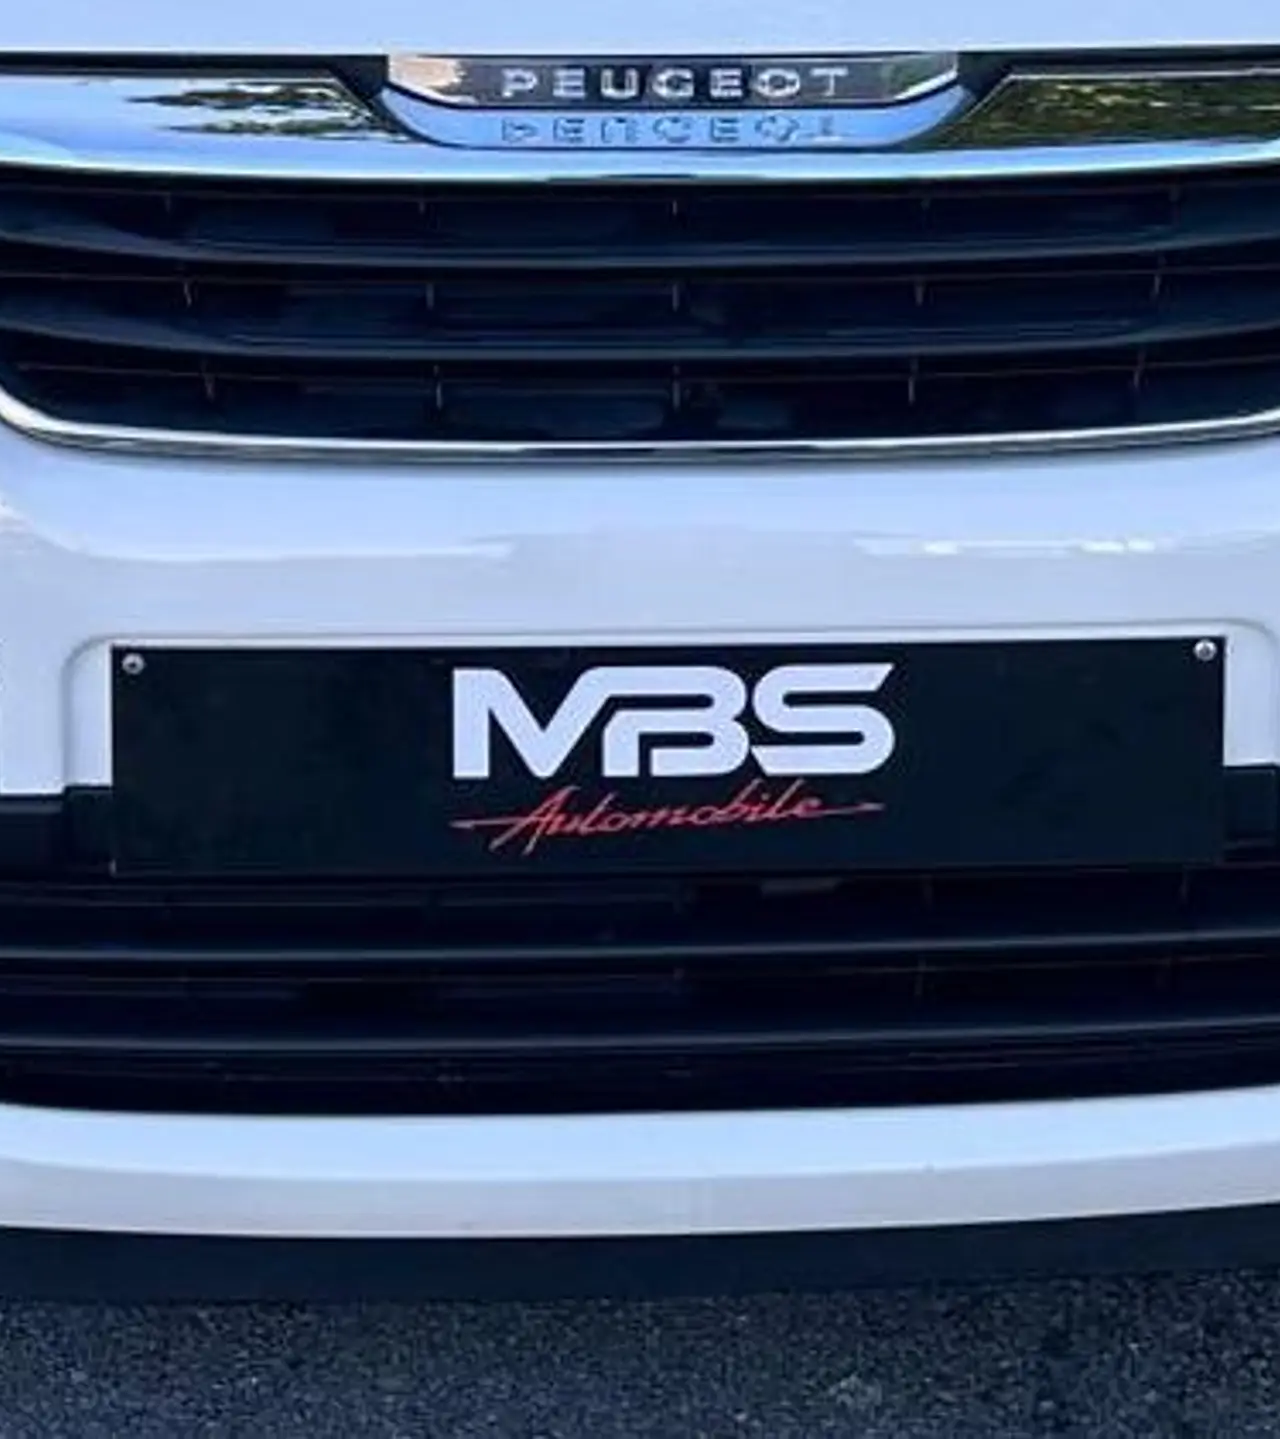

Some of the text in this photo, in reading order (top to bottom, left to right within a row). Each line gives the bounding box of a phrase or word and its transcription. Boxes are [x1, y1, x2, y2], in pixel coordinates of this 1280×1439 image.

[501, 68, 849, 98] PEUGEOT
[452, 662, 896, 778] MBS
[451, 778, 883, 855] Automobile
